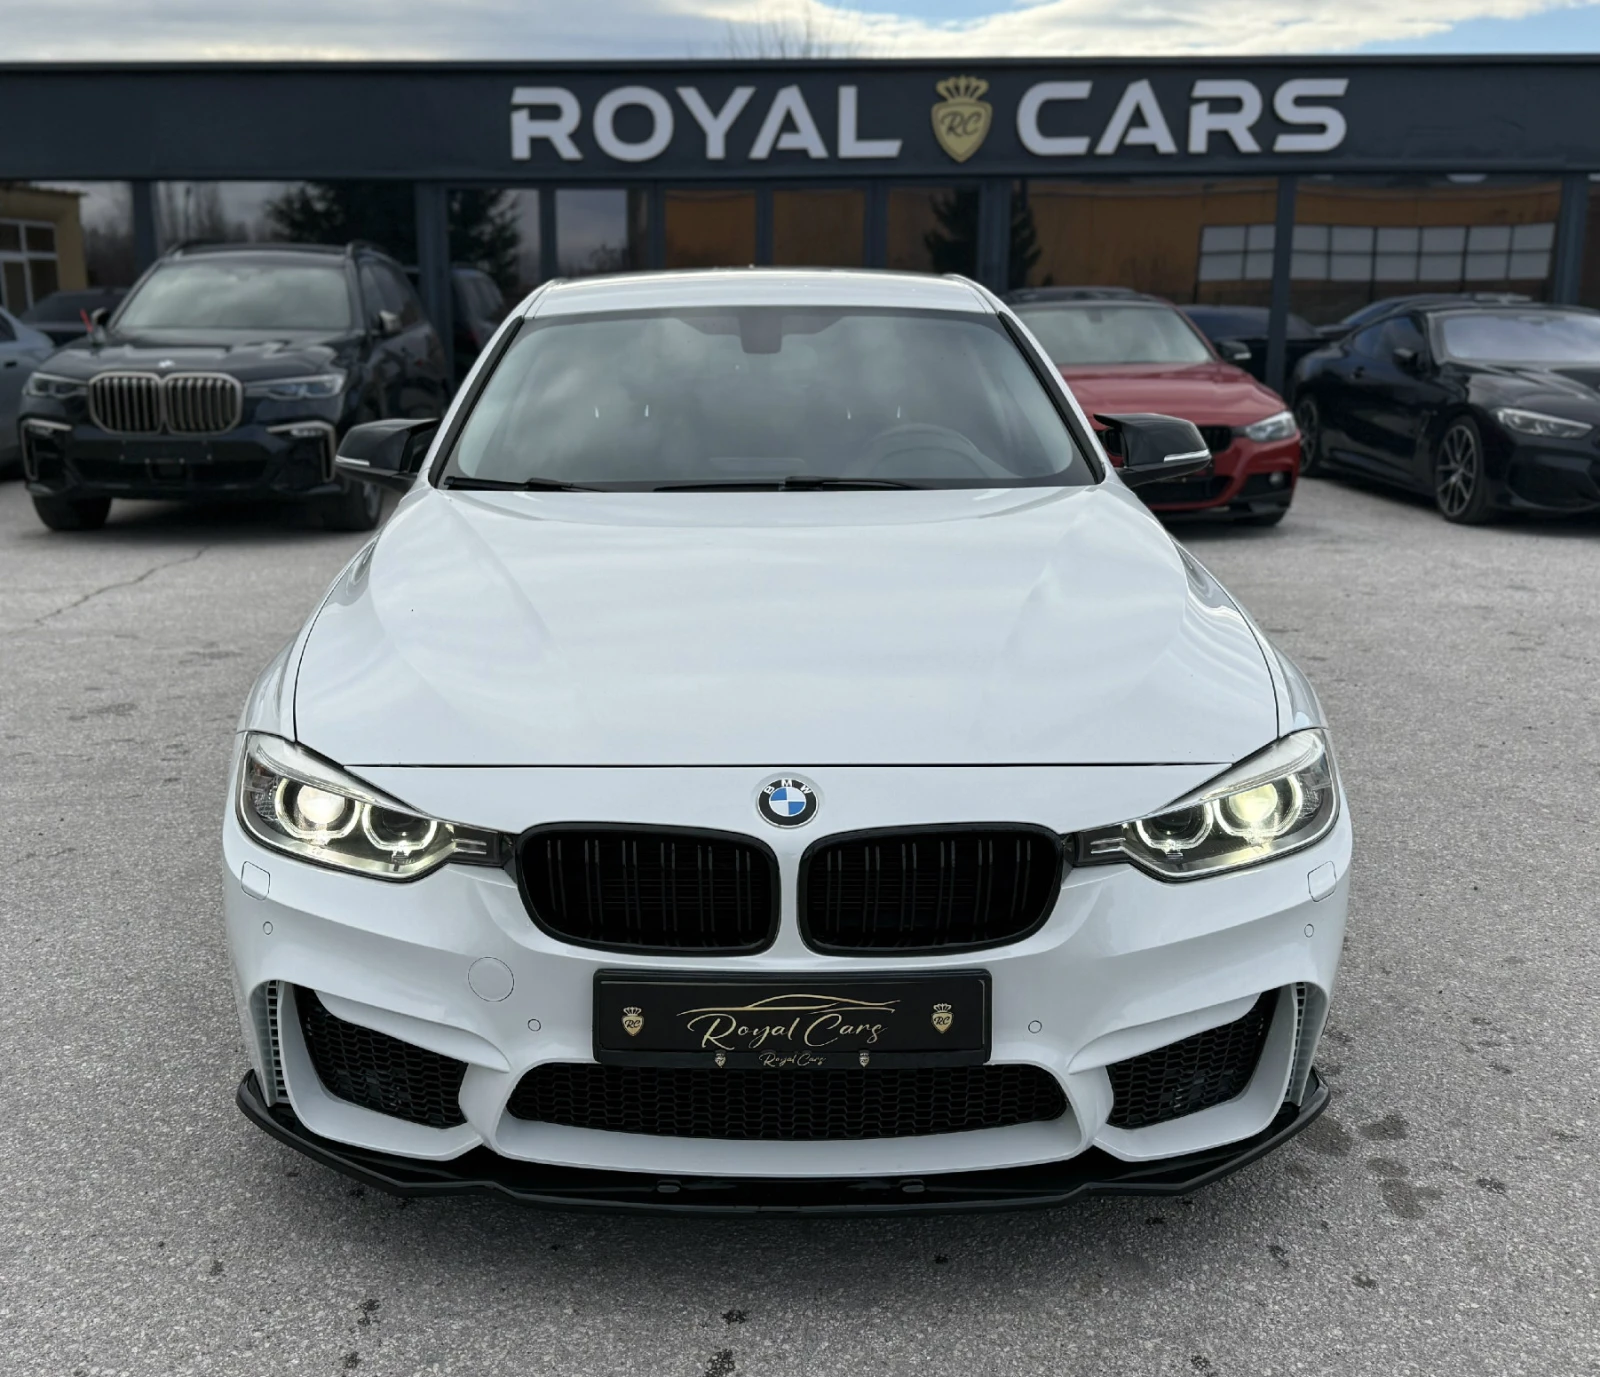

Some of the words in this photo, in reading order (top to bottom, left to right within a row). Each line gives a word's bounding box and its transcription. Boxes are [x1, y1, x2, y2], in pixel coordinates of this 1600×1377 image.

[510, 84, 903, 163] ROYAL
[1016, 78, 1350, 156] CARS
[940, 109, 983, 138] RC
[764, 779, 812, 795] BMW
[687, 1013, 801, 1051] Royal
[803, 1013, 888, 1047] Cars
[758, 1051, 798, 1068] Royal
[796, 1052, 827, 1067] Cars
